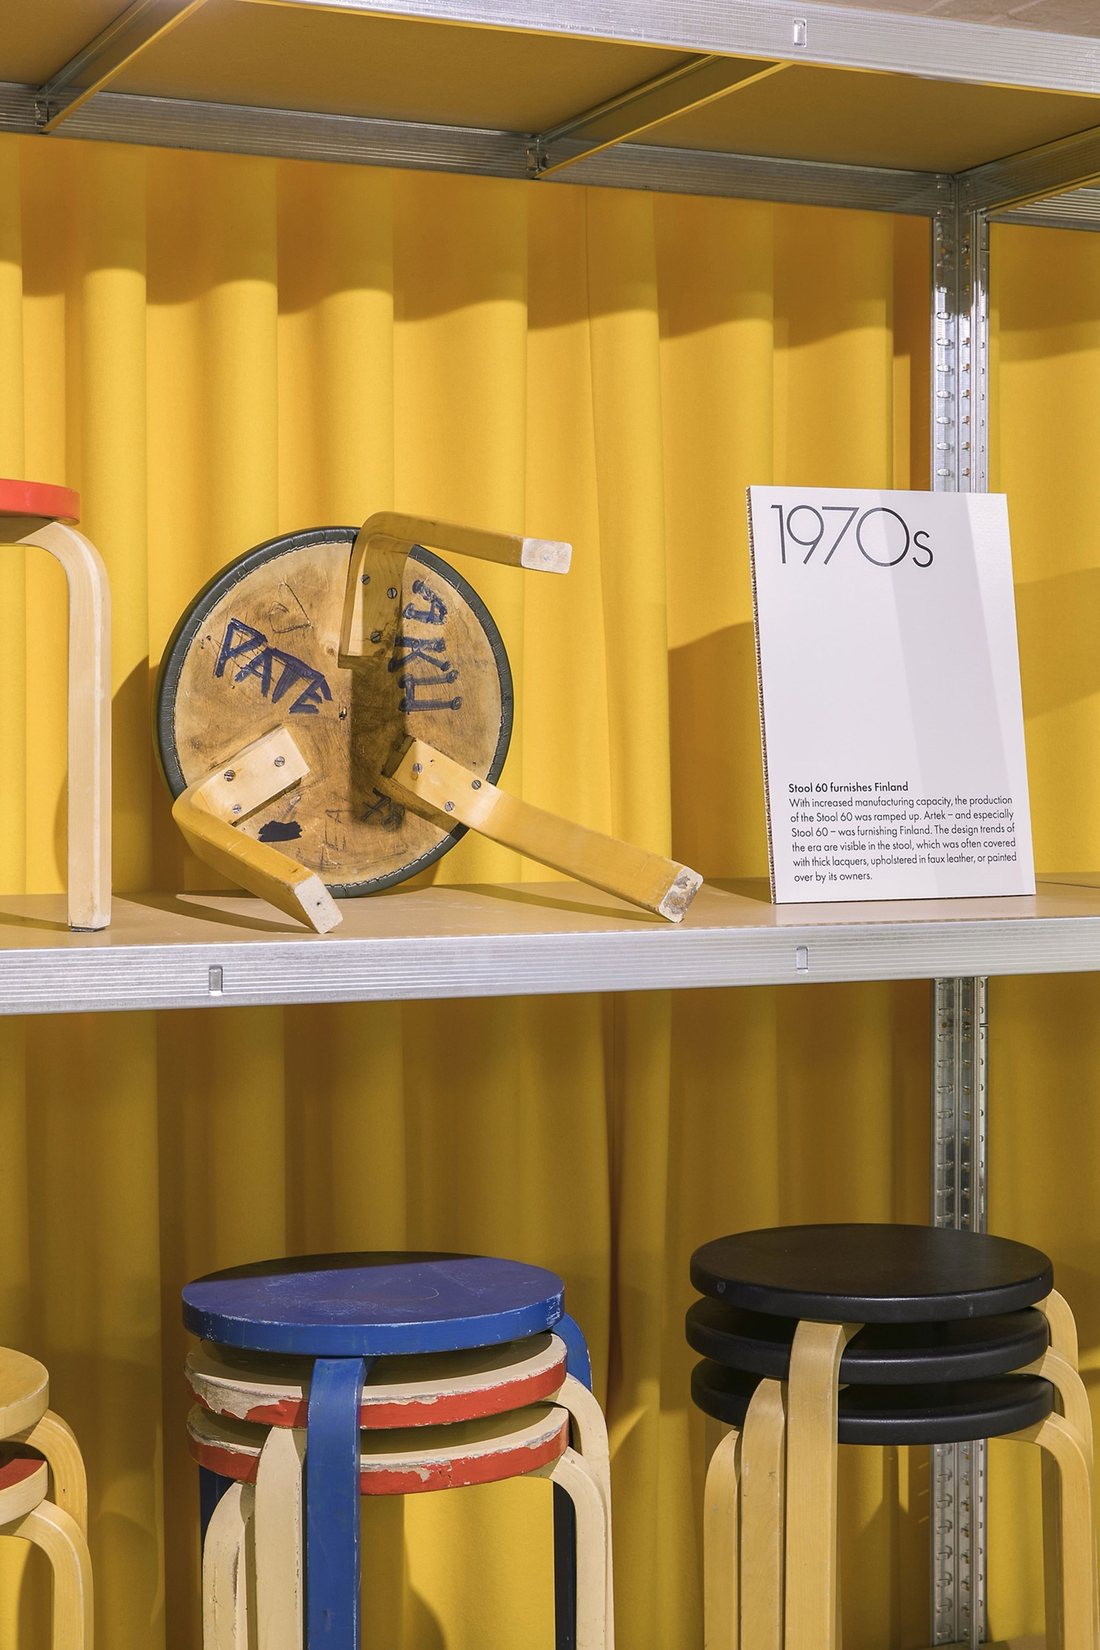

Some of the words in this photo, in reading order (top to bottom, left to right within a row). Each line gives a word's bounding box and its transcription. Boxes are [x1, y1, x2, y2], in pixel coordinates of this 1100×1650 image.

[771, 504, 933, 567] 1970s
[213, 617, 332, 713] PATE
[789, 783, 813, 793] Stool
[815, 783, 828, 793] 60
[830, 782, 873, 792] furnishes
[875, 782, 909, 792] Finland
[789, 798, 811, 808] With
[812, 797, 853, 808] increased
[855, 796, 914, 808] manufacturing
[916, 797, 954, 808] capacity,
[955, 796, 968, 805] the
[970, 795, 1013, 807] production
[791, 812, 800, 823] of
[801, 813, 815, 823] the
[817, 812, 839, 822] Stool
[841, 812, 853, 822] 60
[874, 811, 907, 823] ramped
[909, 815, 922, 823] up.
[924, 810, 946, 820] Artek
[955, 810, 971, 820] and
[973, 809, 1014, 821] especially
[792, 827, 814, 838] Stool
[816, 827, 829, 837] 60
[838, 829, 856, 837] was
[858, 826, 898, 838] furnishing
[900, 824, 933, 835] Finland.
[934, 825, 950, 834] The
[951, 824, 979, 836] design
[980, 823, 1005, 834] trends
[1007, 823, 1015, 833] of
[792, 842, 805, 852] the
[808, 844, 822, 852] era
[824, 844, 838, 852] are
[840, 841, 867, 851] visible
[868, 842, 876, 851] in
[878, 841, 891, 850] the
[892, 840, 914, 851] stool,
[916, 839, 941, 849] which
[942, 841, 960, 849] was
[961, 838, 982, 849] often
[983, 838, 1016, 848] covered
[793, 857, 810, 867] with
[812, 856, 831, 867] thick
[832, 856, 869, 868] lacquers,
[870, 854, 917, 868] upholstered
[919, 855, 927, 863] in
[928, 853, 946, 863] faux
[947, 853, 976, 864] leather,
[977, 854, 986, 862] or
[988, 852, 1017, 865] painted
[794, 873, 814, 882] over
[816, 872, 827, 884] by
[829, 872, 838, 881] its
[840, 873, 873, 881] owners.
